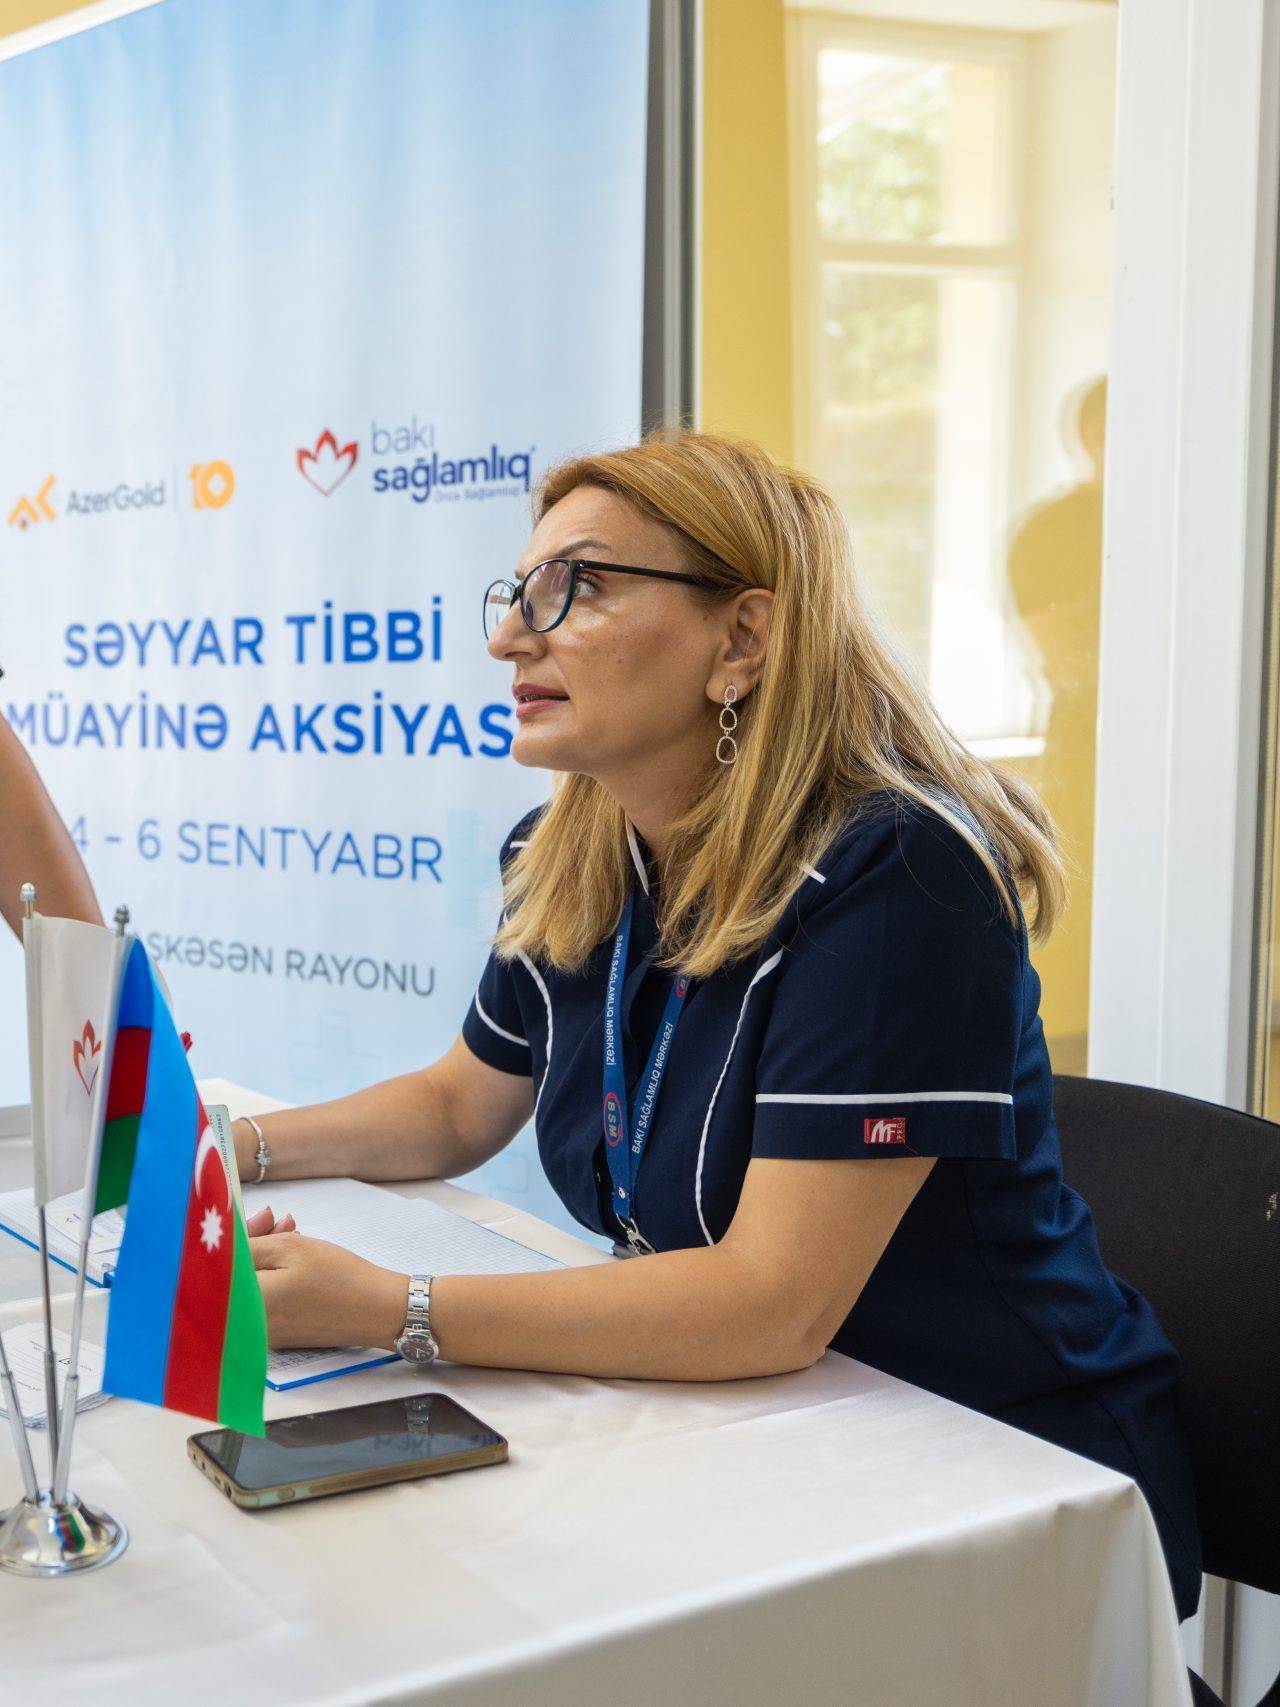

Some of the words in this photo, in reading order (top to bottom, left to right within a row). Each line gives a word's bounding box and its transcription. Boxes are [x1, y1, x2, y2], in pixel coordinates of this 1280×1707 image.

[66, 479, 166, 514] AzerGold
[373, 444, 529, 503] sağlamlıq
[64, 617, 265, 667] SƏYYAR
[285, 596, 442, 665] TİBBİ
[7, 690, 228, 750] MÜAYİNƏ
[250, 691, 513, 758] AKSİYAS
[137, 818, 162, 860] 6
[177, 821, 443, 883] SENTYABR
[285, 948, 436, 998] RAYONU
[631, 1129, 645, 1154] BAKI
[641, 1069, 661, 1128] SAĞLAMLIQ
